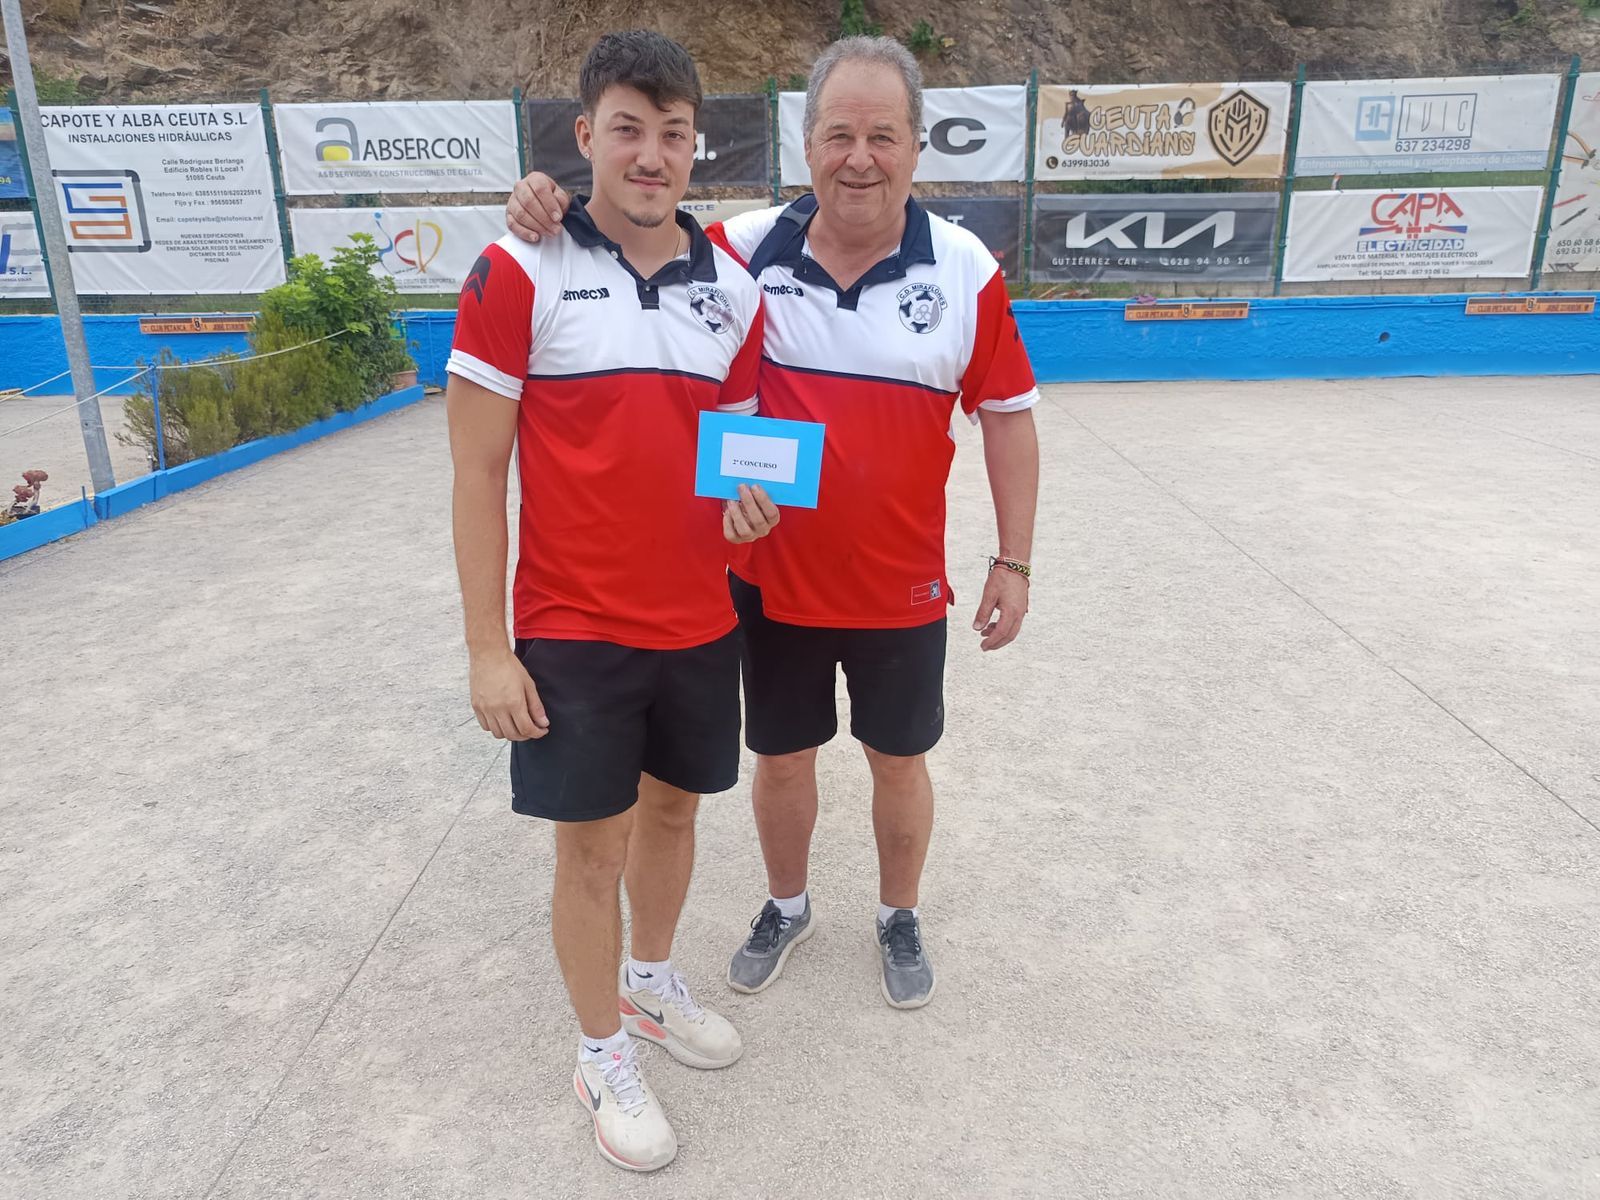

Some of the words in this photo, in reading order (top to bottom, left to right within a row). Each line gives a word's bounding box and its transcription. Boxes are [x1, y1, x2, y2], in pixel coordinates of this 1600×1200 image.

[40, 114, 102, 128] CAPOTE
[106, 114, 116, 128] Y
[122, 113, 164, 127] ALBA
[168, 112, 219, 127] CEUTA
[223, 112, 248, 126] S.L
[1089, 104, 1172, 131] CEUTA
[68, 133, 156, 143] INSTALACIONES
[158, 130, 232, 142] HIDRÁULICAS
[362, 137, 480, 161] ABSERCON
[1395, 141, 1418, 152] 637
[1422, 139, 1471, 152] 234298
[1371, 158, 1413, 170] personal
[1415, 159, 1420, 168] y
[1488, 155, 1501, 164] de
[1371, 193, 1464, 226] CAPA
[1066, 211, 1236, 248] KIA
[1357, 239, 1464, 252] ELECTRICIDAD
[1052, 256, 1110, 265] GUTIÉRREZ
[911, 284, 945, 306] MIRAFLORES
[740, 460, 777, 469] CONCURSO
